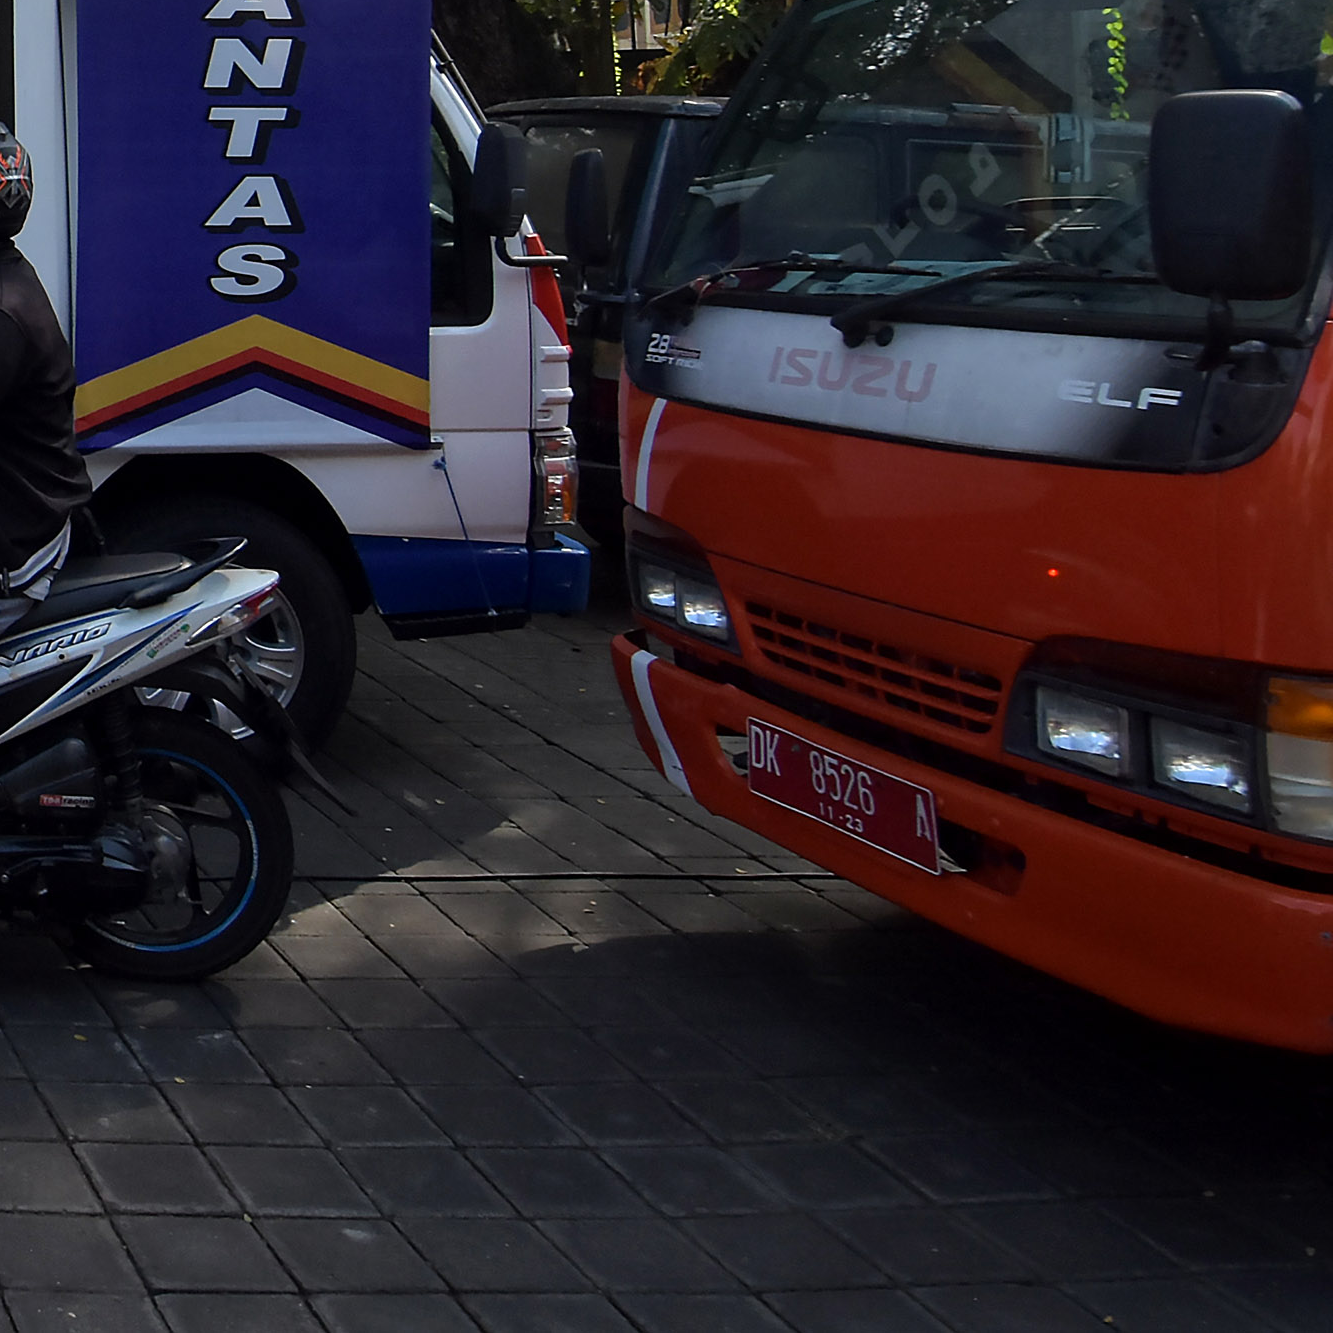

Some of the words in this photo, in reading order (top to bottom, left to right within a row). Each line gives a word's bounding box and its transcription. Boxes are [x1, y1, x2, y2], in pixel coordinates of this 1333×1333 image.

[648, 332, 671, 354] 28
[645, 353, 674, 365] SOFT
[767, 346, 938, 404] ISUZU
[1057, 379, 1183, 410] ELF
[750, 724, 781, 777] DK
[809, 751, 875, 816] 8526
[915, 793, 933, 842] A
